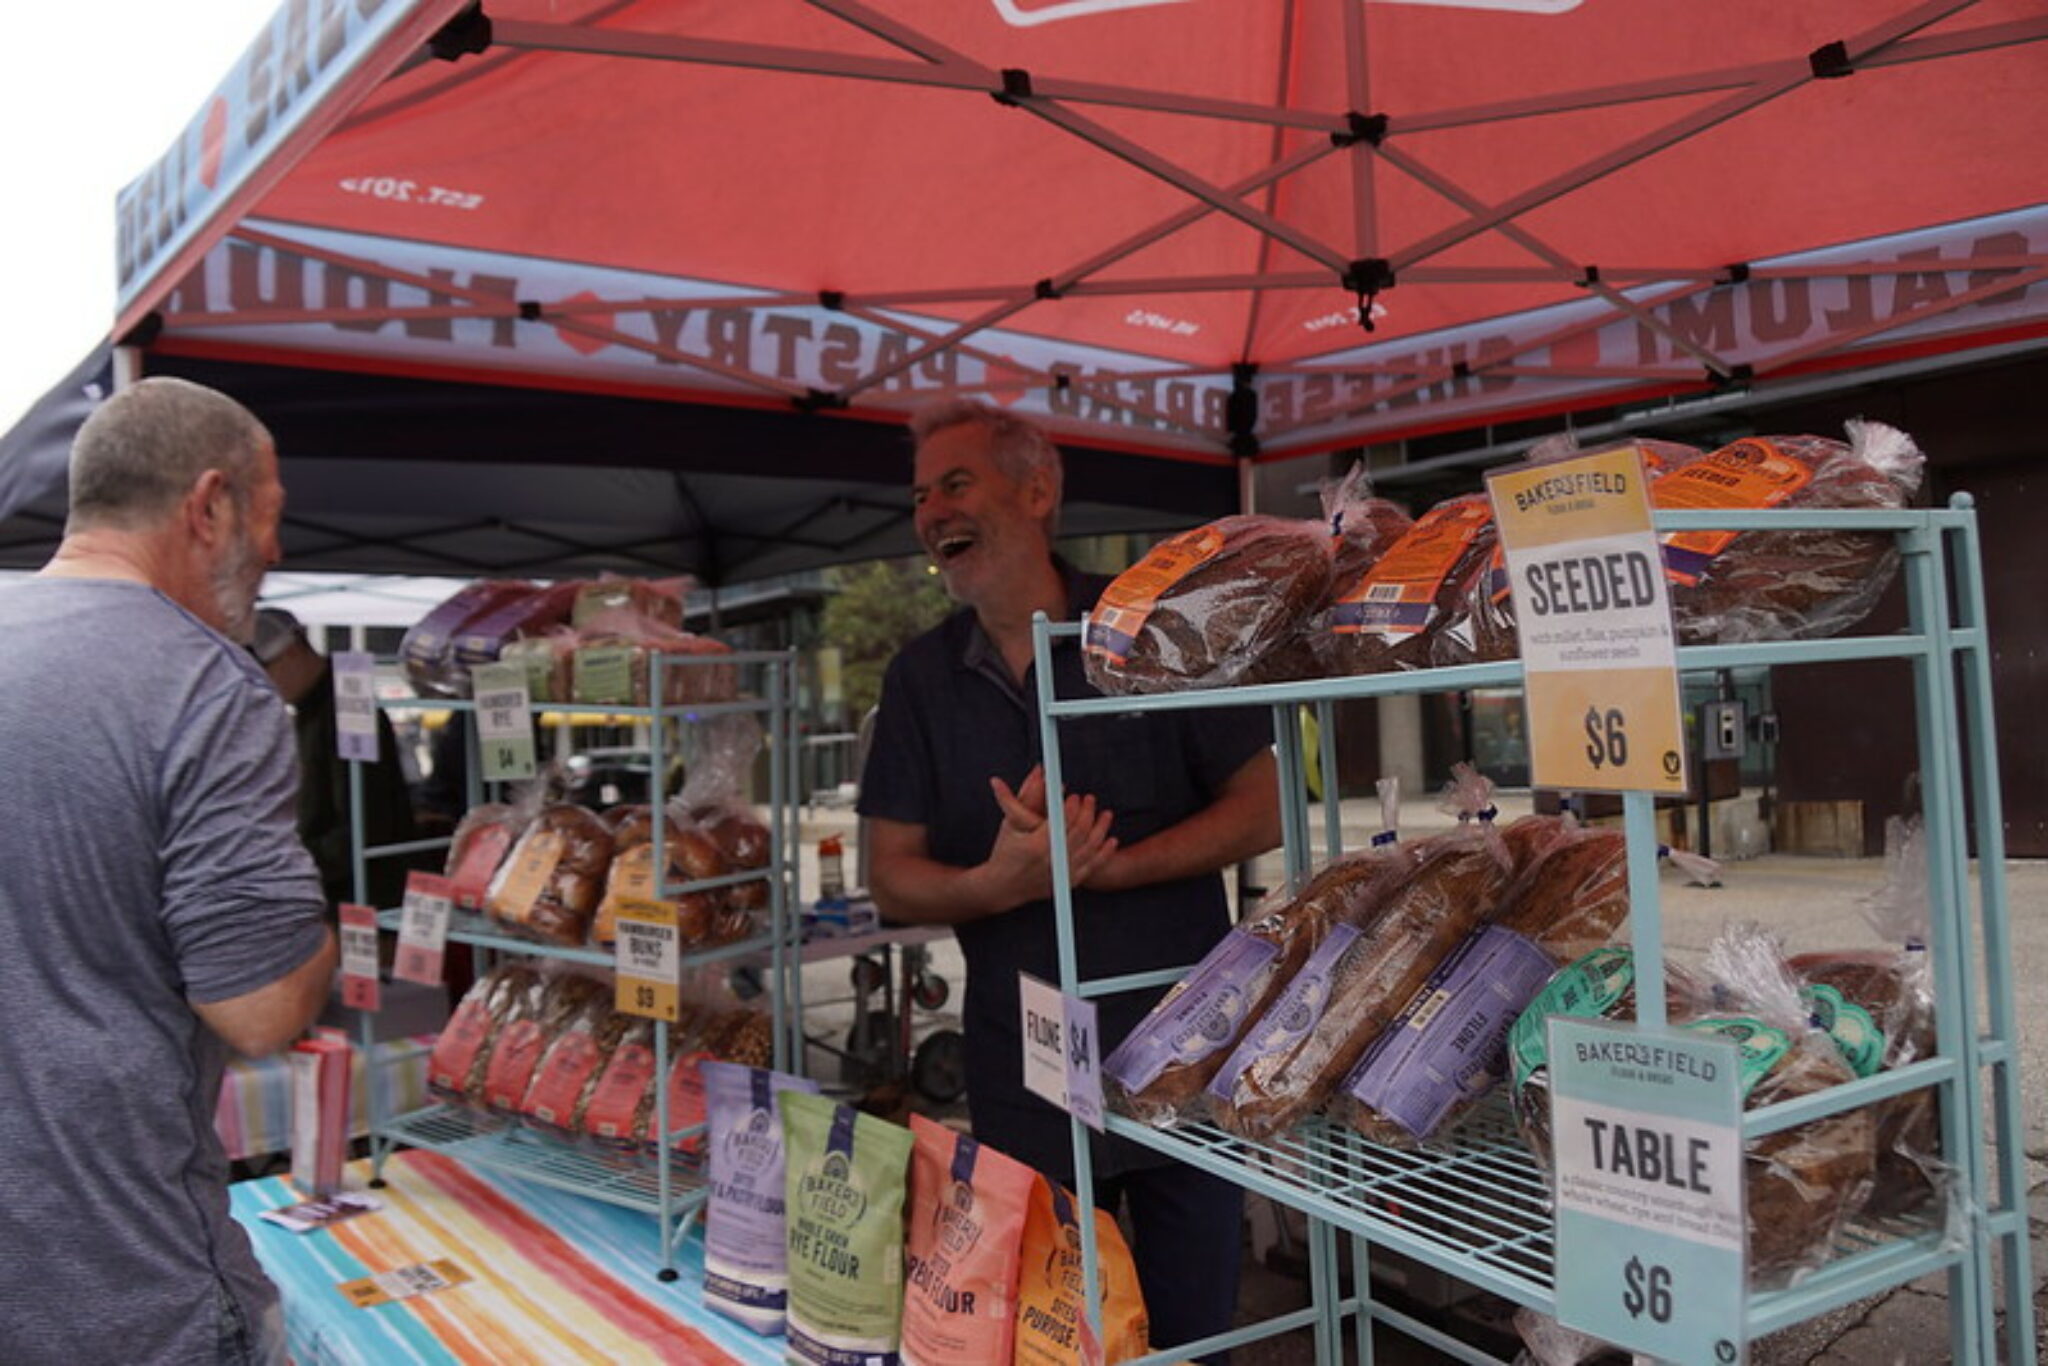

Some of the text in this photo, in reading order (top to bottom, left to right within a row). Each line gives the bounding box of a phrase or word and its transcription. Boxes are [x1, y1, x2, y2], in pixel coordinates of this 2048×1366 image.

[1525, 552, 1657, 617] SEEDED
[1585, 707, 1629, 769] $6
[1027, 1009, 1062, 1054] FILONE
[1070, 1020, 1090, 1074] $4
[1584, 1116, 1711, 1195] TABLE
[813, 1239, 860, 1281] FLOUR
[1623, 1256, 1672, 1323] $6
[1022, 1305, 1075, 1349] PURPOSE
